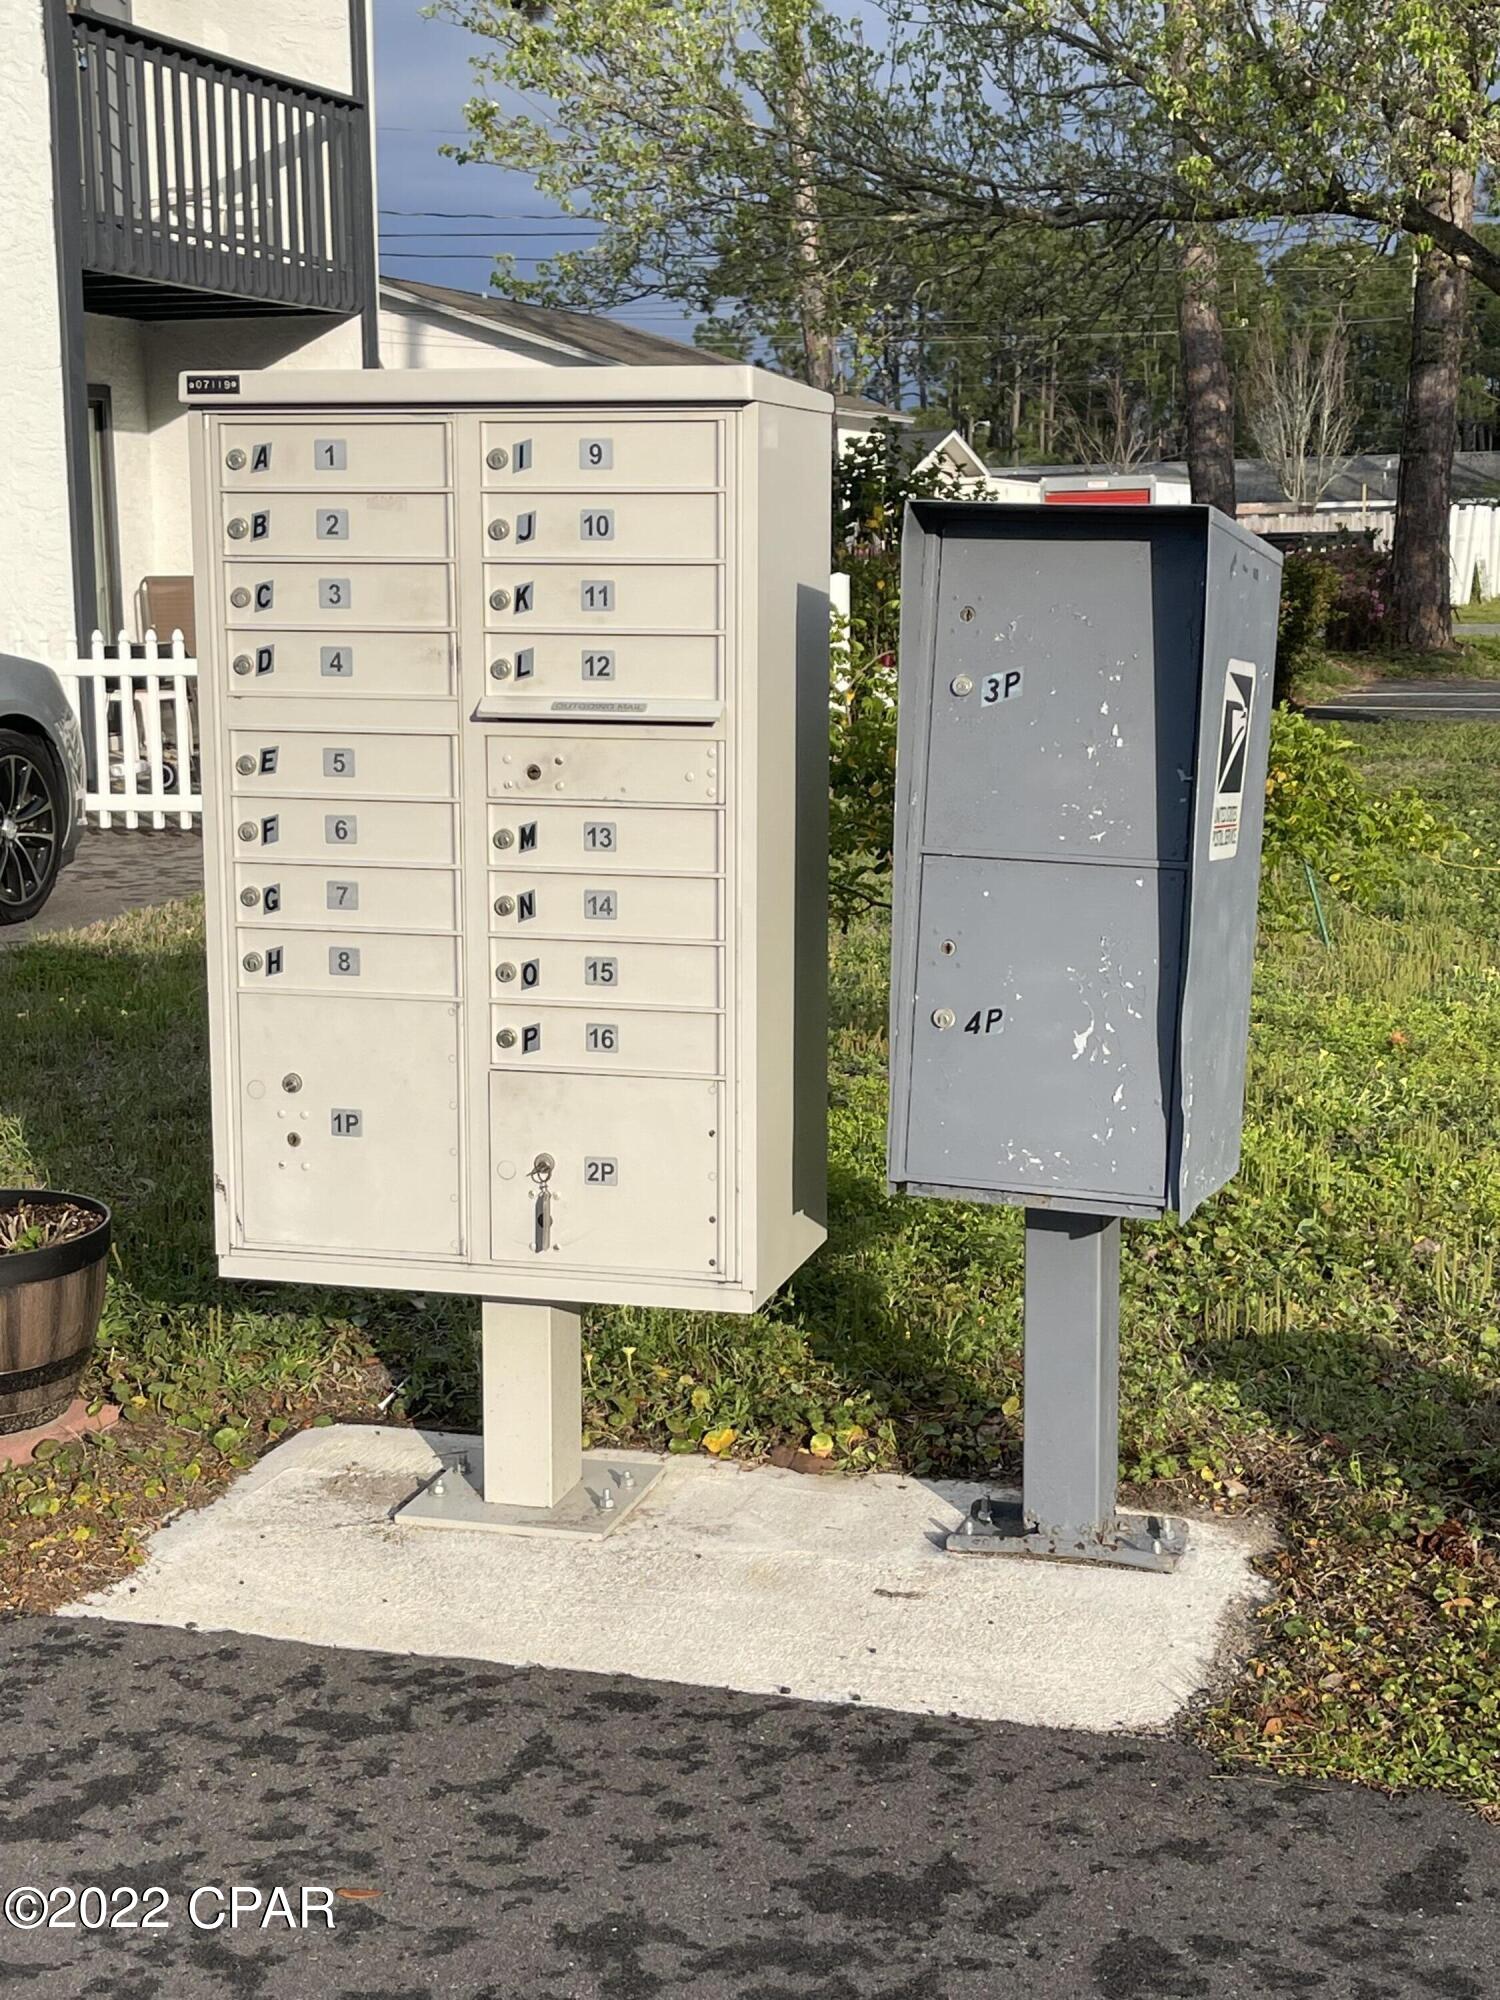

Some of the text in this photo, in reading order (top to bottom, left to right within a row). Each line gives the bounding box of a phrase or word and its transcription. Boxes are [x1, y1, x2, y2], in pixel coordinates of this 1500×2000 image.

[253, 445, 268, 471] A
[324, 444, 334, 467] 1
[589, 443, 603, 465] 9
[252, 513, 267, 539] B
[326, 514, 339, 536] 2
[517, 514, 533, 541] J
[583, 514, 609, 537] 10
[256, 584, 271, 609] C
[329, 583, 341, 605] 3
[514, 584, 531, 613] K
[584, 585, 608, 607] 11
[257, 648, 273, 674] D
[329, 652, 343, 673] 4
[516, 653, 531, 678] L
[584, 655, 611, 677] 12
[983, 671, 1021, 703] 3P
[260, 748, 277, 773] E
[333, 753, 346, 773] 5
[262, 816, 277, 844] F
[334, 819, 348, 841] 6
[519, 823, 536, 851] M
[587, 826, 613, 849] 13
[264, 887, 279, 911] G
[335, 885, 349, 906] 7
[519, 892, 534, 920] N
[587, 895, 613, 916] 14
[267, 949, 281, 975] H
[338, 951, 351, 972] 8
[588, 961, 614, 983] 15
[522, 962, 538, 986] O
[963, 1008, 1003, 1035] 4P
[522, 1026, 538, 1054] P
[589, 1028, 614, 1049] 16
[333, 1113, 359, 1134] 1P
[587, 1161, 615, 1182] 2P
